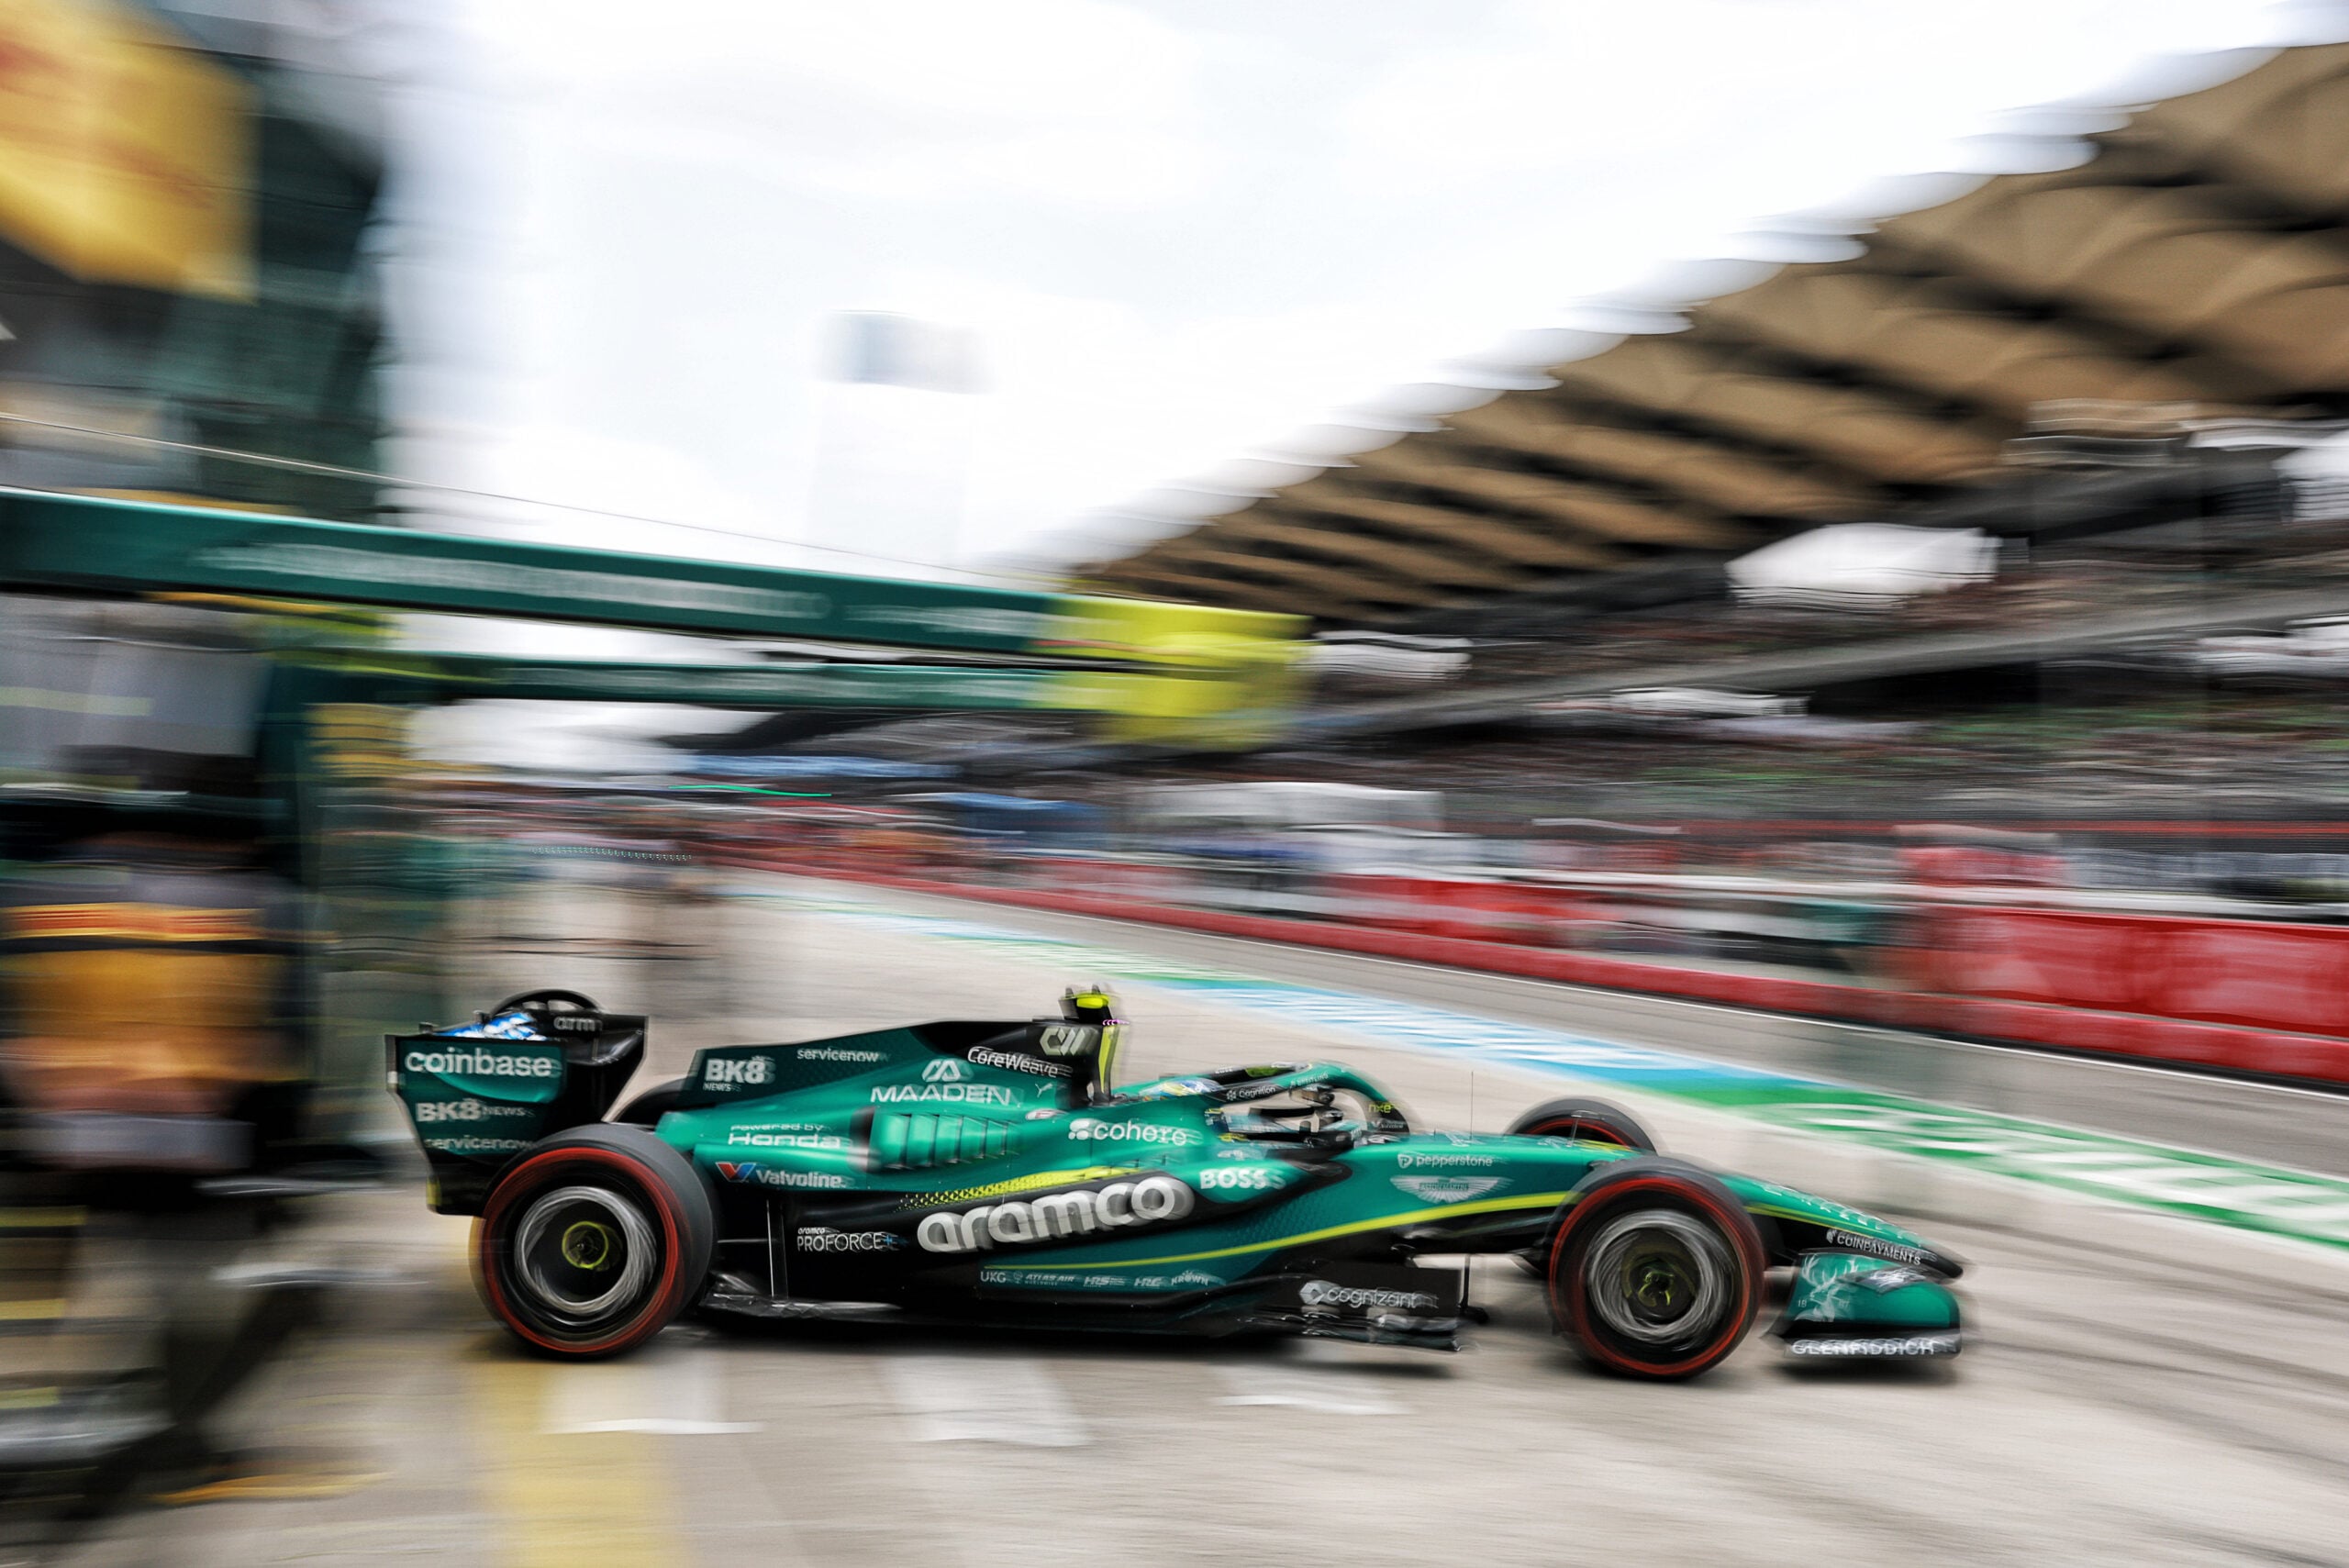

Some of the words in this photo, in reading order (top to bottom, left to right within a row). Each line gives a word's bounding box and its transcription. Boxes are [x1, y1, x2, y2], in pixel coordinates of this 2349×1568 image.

[404, 1047, 561, 1078] coinbase
[797, 1048, 885, 1062] servicenow
[967, 1046, 1063, 1078] CoreWeave
[706, 1056, 774, 1084] BK8
[871, 1084, 1019, 1106] MAADEN
[1239, 1086, 1275, 1098] Cognition
[417, 1099, 483, 1122] BK8
[728, 1133, 846, 1148] Honda
[1094, 1120, 1196, 1146] cohere
[1416, 1154, 1496, 1168] pepperstone
[756, 1170, 849, 1189] Valvoline
[1199, 1169, 1279, 1190] BOSS
[918, 1176, 1195, 1253] aramco
[1836, 1234, 1923, 1267] COINPAYMENTS
[980, 1271, 1008, 1284] UKG
[1328, 1285, 1420, 1308] cognizant
[1790, 1338, 1938, 1356] GLENFIDDICH
